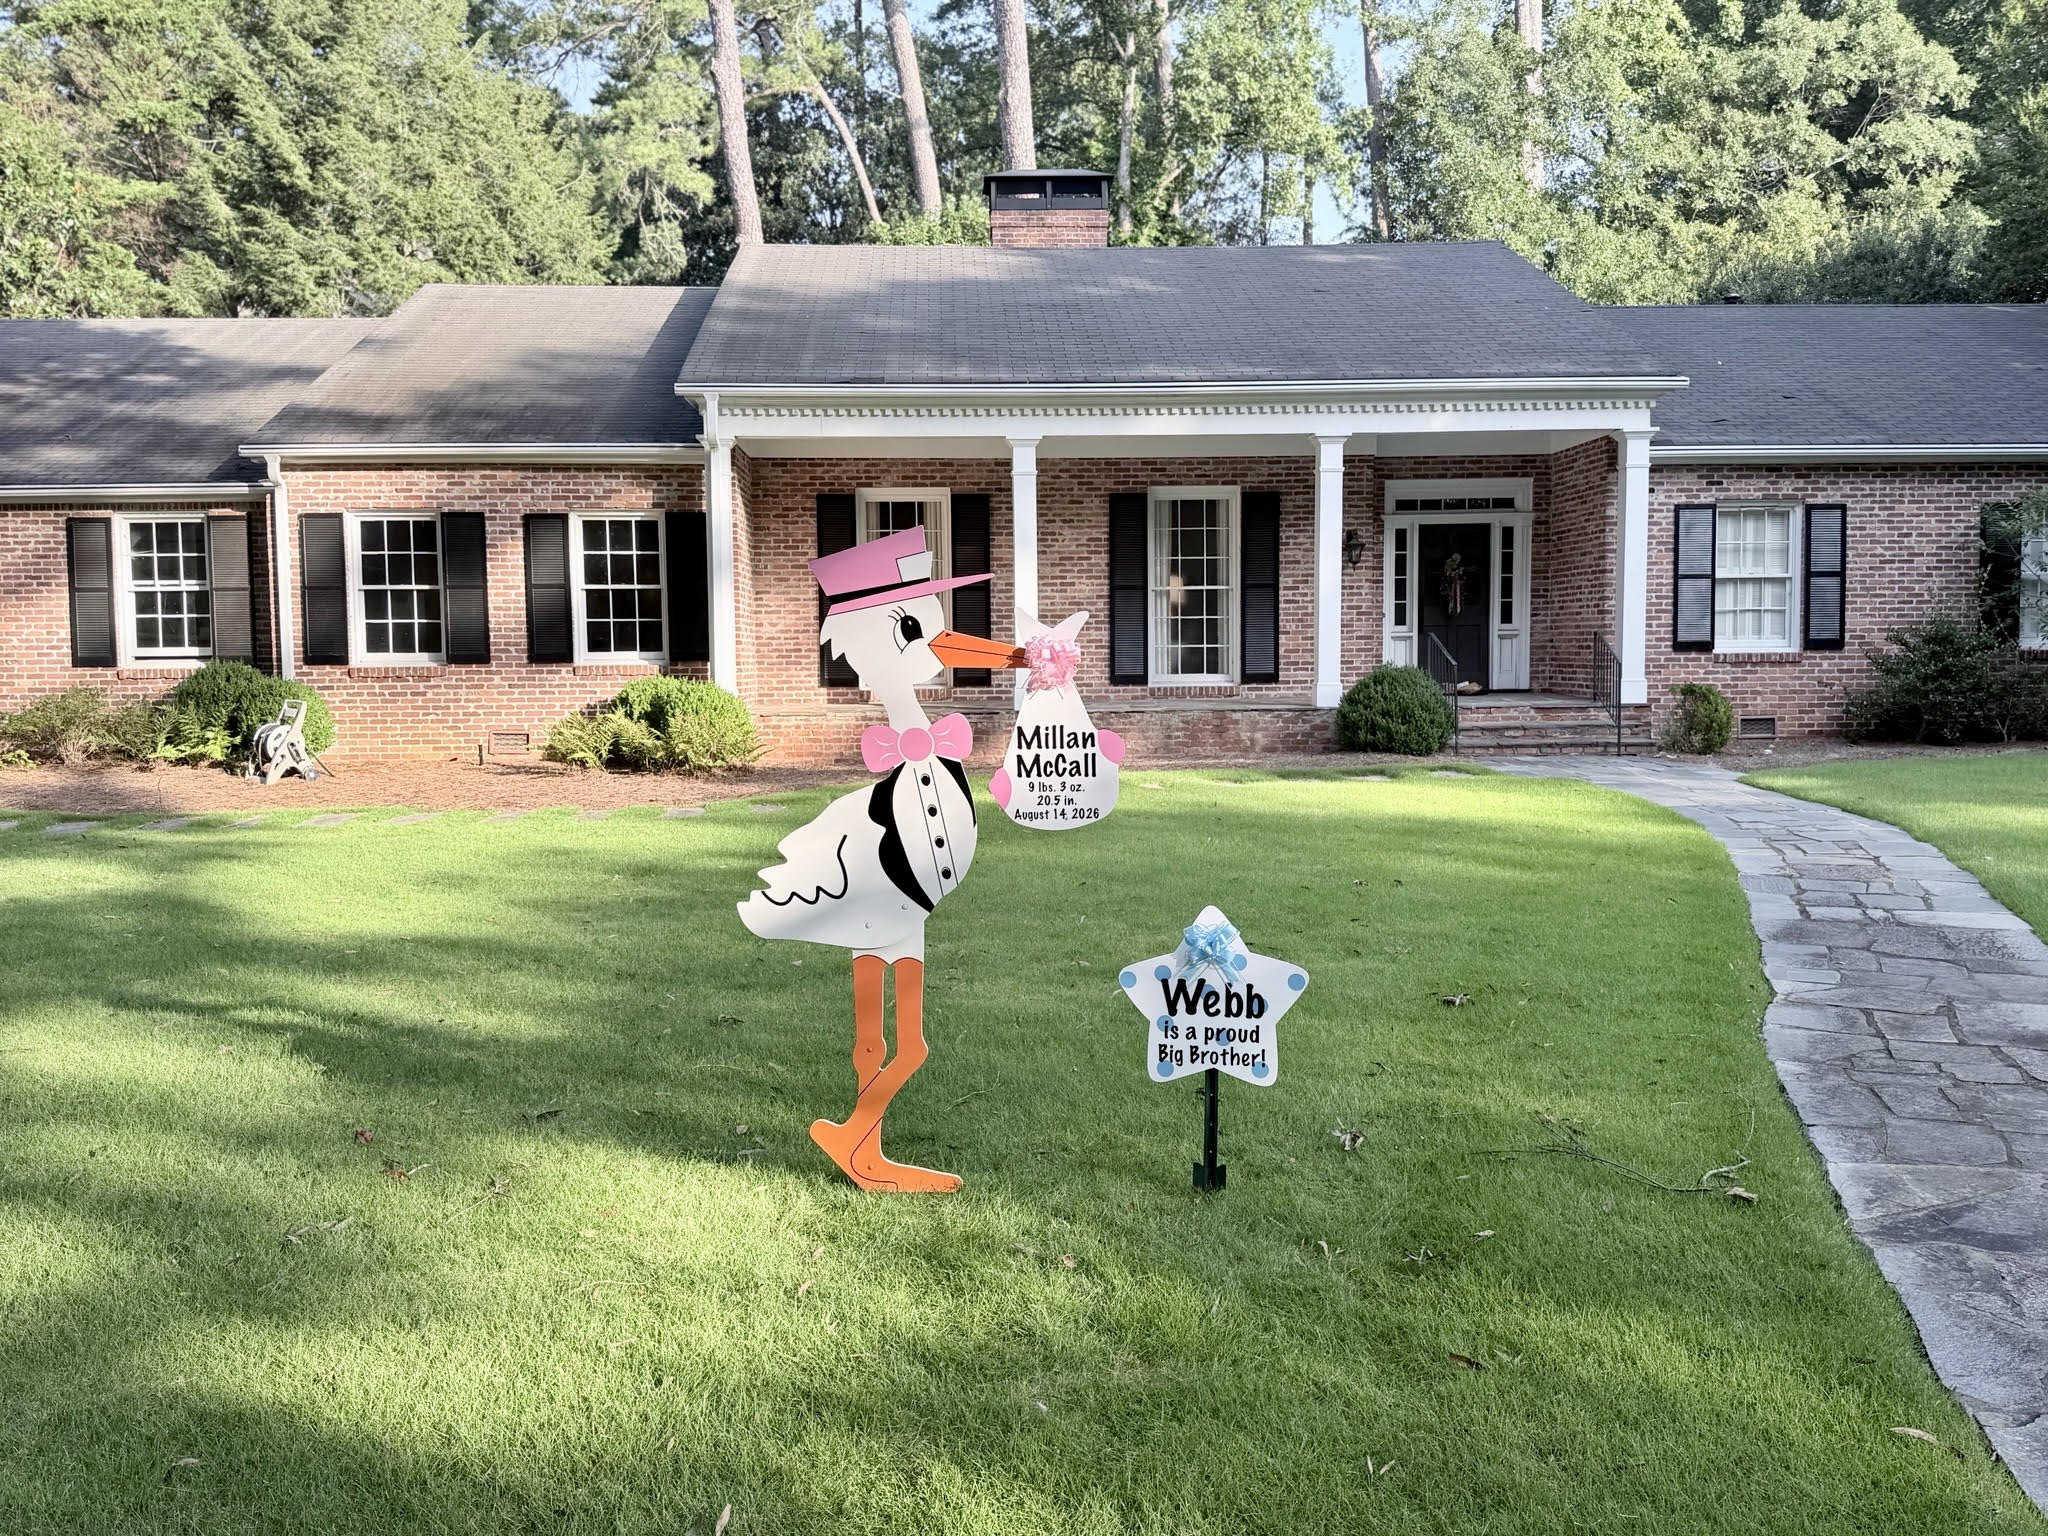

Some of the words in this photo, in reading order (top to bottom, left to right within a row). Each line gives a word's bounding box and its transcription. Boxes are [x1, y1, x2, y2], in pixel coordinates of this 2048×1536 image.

[1016, 725, 1096, 751] Millan
[1016, 753, 1097, 778] McCall
[1028, 781, 1035, 793] 9
[1038, 781, 1057, 793] lbs.
[1059, 781, 1067, 792] 3
[1070, 783, 1085, 793] oz.
[1036, 795, 1061, 806] 20.5
[1064, 795, 1077, 806] in.
[1014, 808, 1050, 822] August
[1053, 808, 1068, 821] 14,
[1071, 807, 1100, 820] 2026
[1160, 977, 1265, 1020] Webb
[1163, 1020, 1179, 1040] is
[1185, 1025, 1197, 1041] a
[1204, 1024, 1260, 1045] proud
[1158, 1043, 1184, 1067] Big
[1190, 1044, 1266, 1068] Brother!
